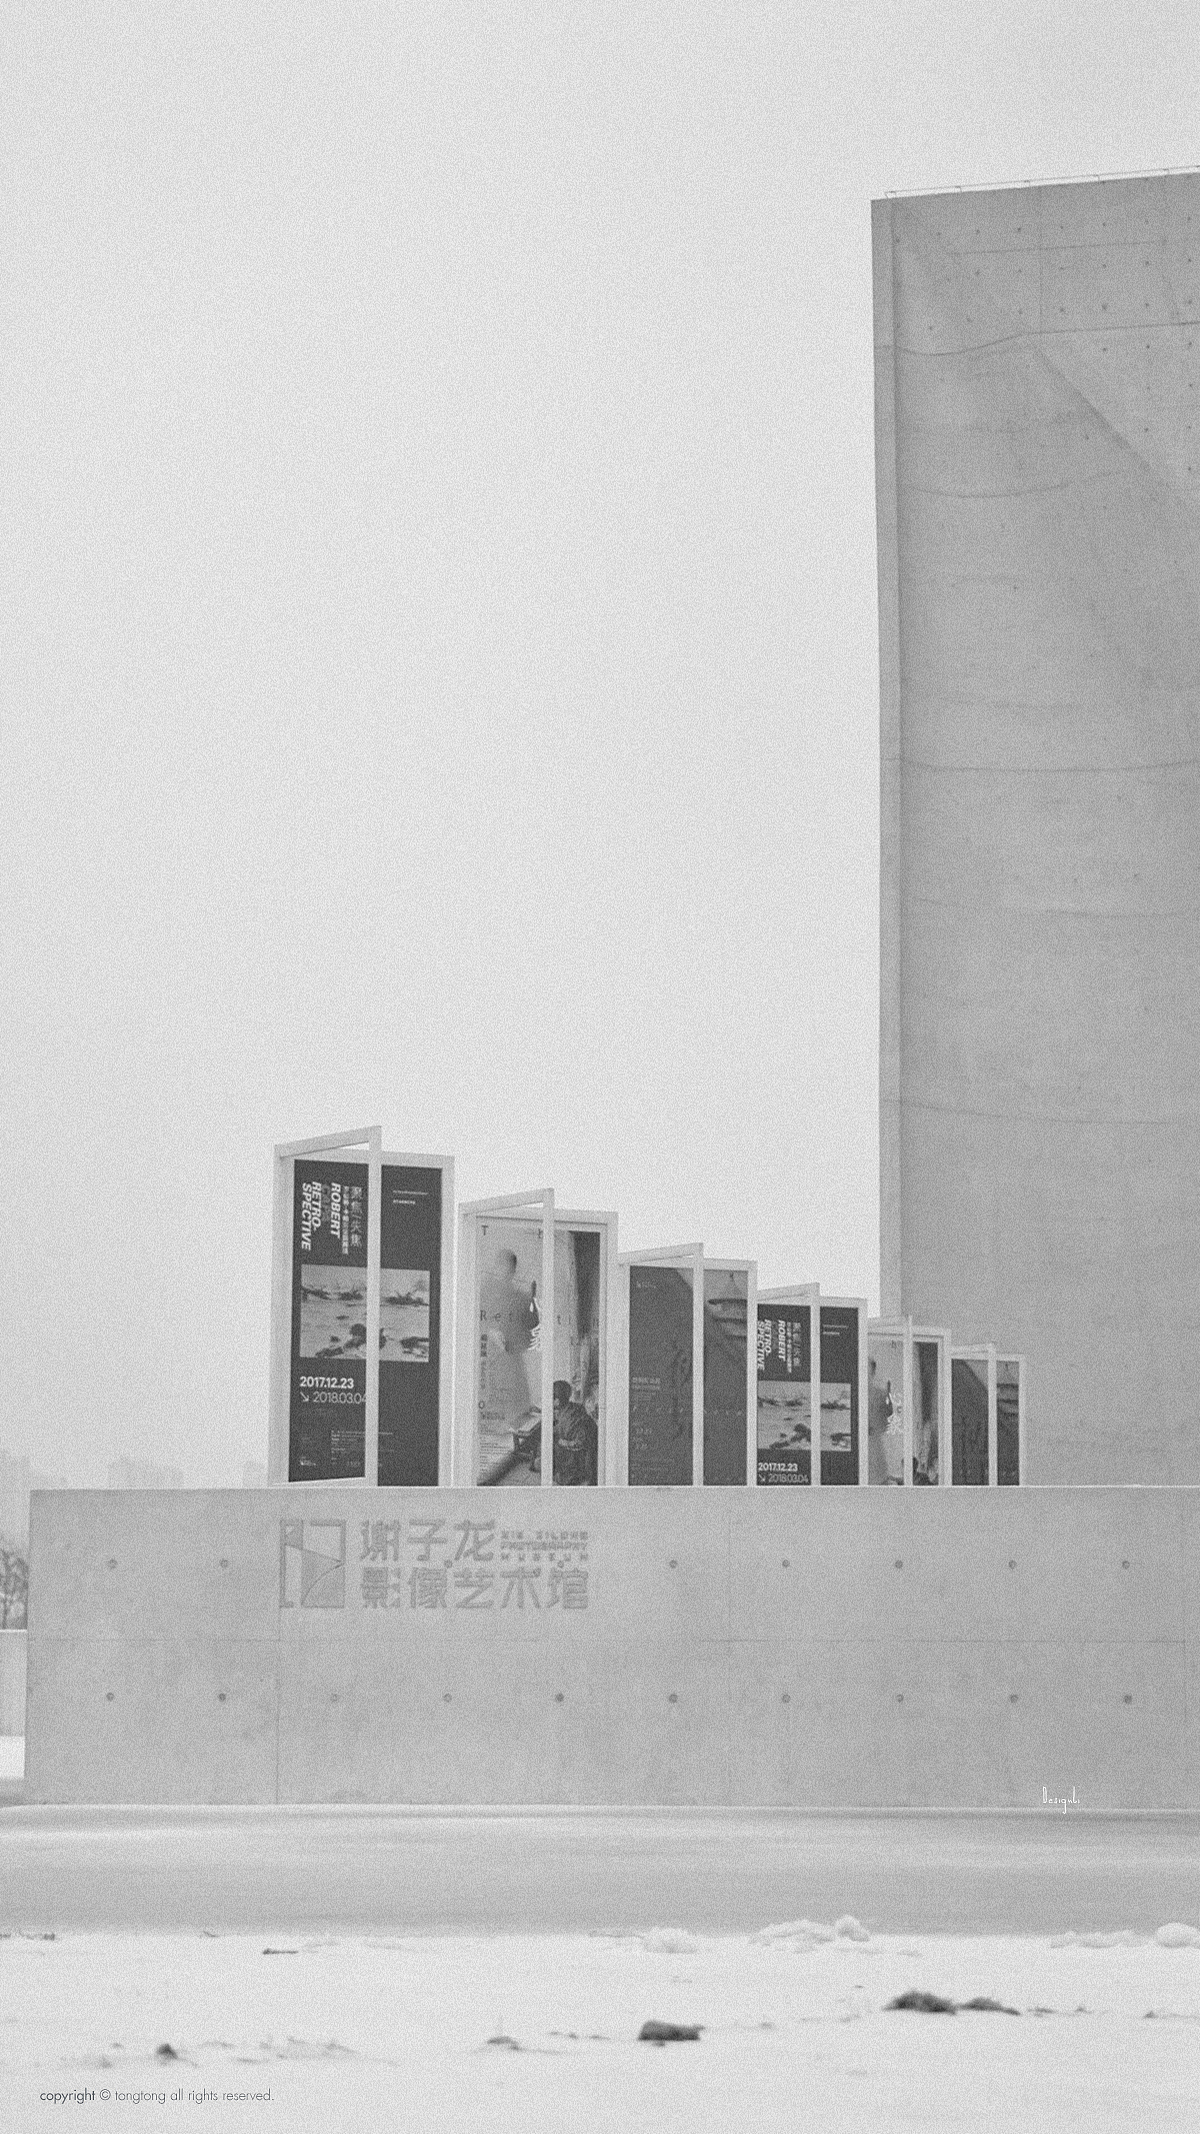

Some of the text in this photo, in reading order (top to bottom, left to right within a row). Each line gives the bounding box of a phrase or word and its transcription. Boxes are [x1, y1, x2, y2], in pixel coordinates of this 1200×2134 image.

[301, 1182, 312, 1251] SPECTIVE
[311, 1181, 322, 1232] RETRO-
[330, 1182, 341, 1239] ROBERT
[757, 1320, 765, 1371] SPECTIVE
[764, 1319, 772, 1356] RETRO-
[778, 1319, 786, 1361] ROBERT
[299, 1376, 354, 1389] 2017.12.23
[758, 1462, 798, 1472] 2017.12.23
[360, 1519, 496, 1561] 谢子龙
[360, 1567, 589, 1609] 影像艺术馆
